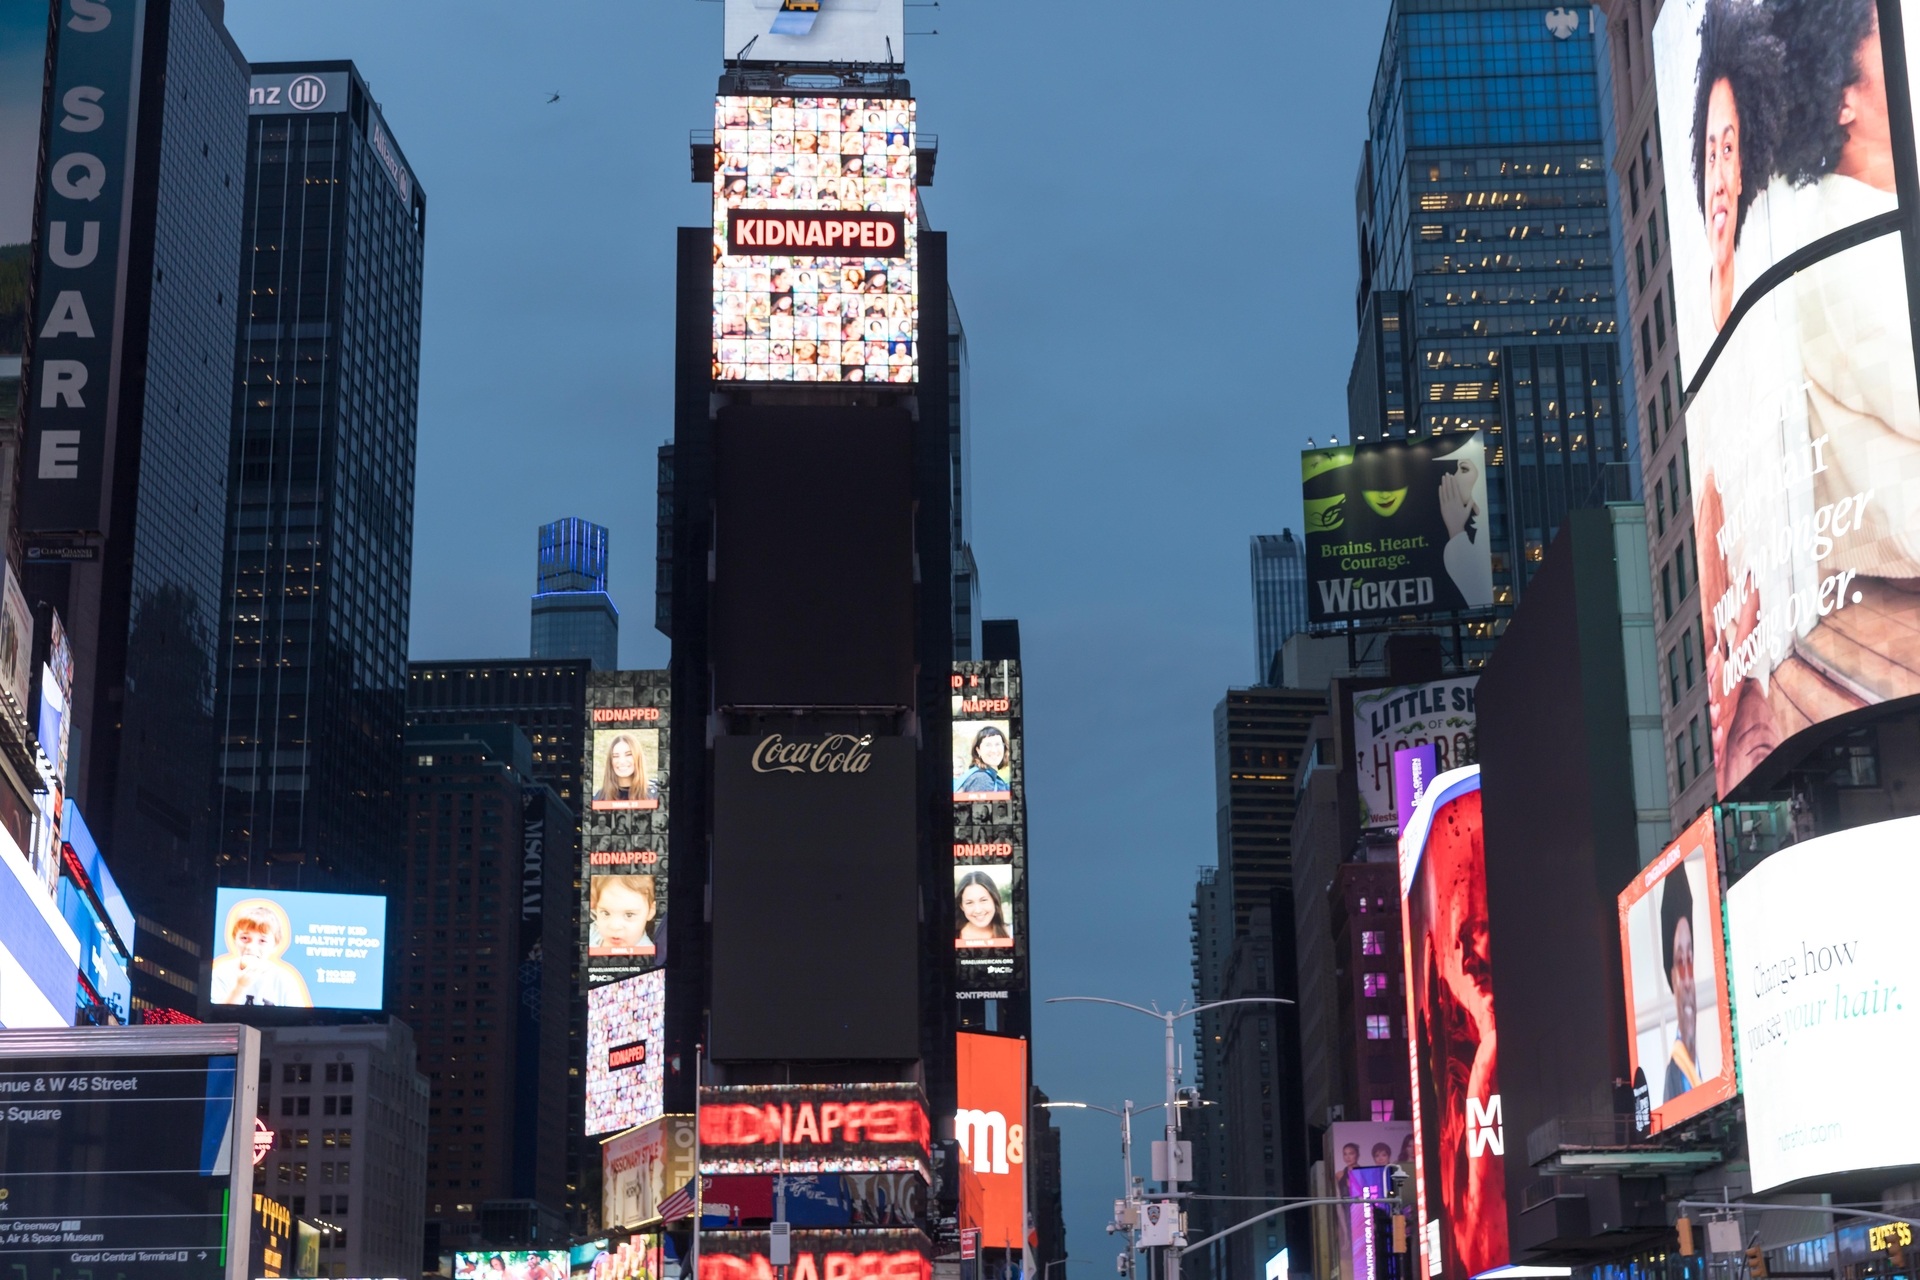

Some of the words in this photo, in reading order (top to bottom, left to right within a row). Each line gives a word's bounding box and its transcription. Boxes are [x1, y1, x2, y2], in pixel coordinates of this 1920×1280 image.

[373, 123, 398, 182] Allianz
[736, 219, 896, 248] KIDNAPPED
[37, 86, 106, 479] SQUARE
[1766, 432, 1829, 505] hair
[1771, 488, 1875, 564] longer
[1321, 541, 1377, 558] Brains.
[1380, 535, 1429, 552] Heart.
[1341, 554, 1411, 571] Courage.
[1723, 606, 1782, 697] obsessing
[1785, 567, 1863, 634] over.
[593, 708, 660, 722] KIDNAPPED
[1371, 687, 1446, 737] LITTLE
[1428, 719, 1444, 729] OF
[751, 733, 872, 774] Coca-Cola
[590, 851, 658, 865] KIDNAPPED
[308, 923, 346, 935] EVERY
[347, 925, 368, 936] KID
[294, 934, 346, 946] HEALTHY
[347, 937, 380, 948] FOOD
[305, 946, 343, 958] EVERY
[344, 948, 368, 959] DAY
[1753, 957, 1797, 999] Change
[1802, 941, 1859, 976] how
[1748, 1023, 1766, 1063] you
[1766, 1013, 1782, 1043] see
[1783, 999, 1827, 1046] your
[1835, 979, 1902, 1020] hair.
[609, 1045, 645, 1067] KIDNAPPED
[0, 1080, 31, 1093] nue
[34, 1078, 46, 1092] &
[50, 1077, 67, 1091] W
[68, 1077, 88, 1091] 45
[91, 1076, 138, 1091] Street
[7, 1106, 62, 1124] Square
[1363, 1186, 1371, 1218] BETER
[13, 1221, 61, 1232] Greenway
[1364, 1218, 1372, 1226] A
[7, 1233, 21, 1243] Air
[22, 1233, 30, 1243] &
[31, 1232, 61, 1245] Space
[63, 1232, 104, 1243] Museum
[1365, 1227, 1373, 1244] FOR
[71, 1252, 100, 1263] Grand
[101, 1252, 137, 1262] Central
[137, 1251, 177, 1262] Terminal
